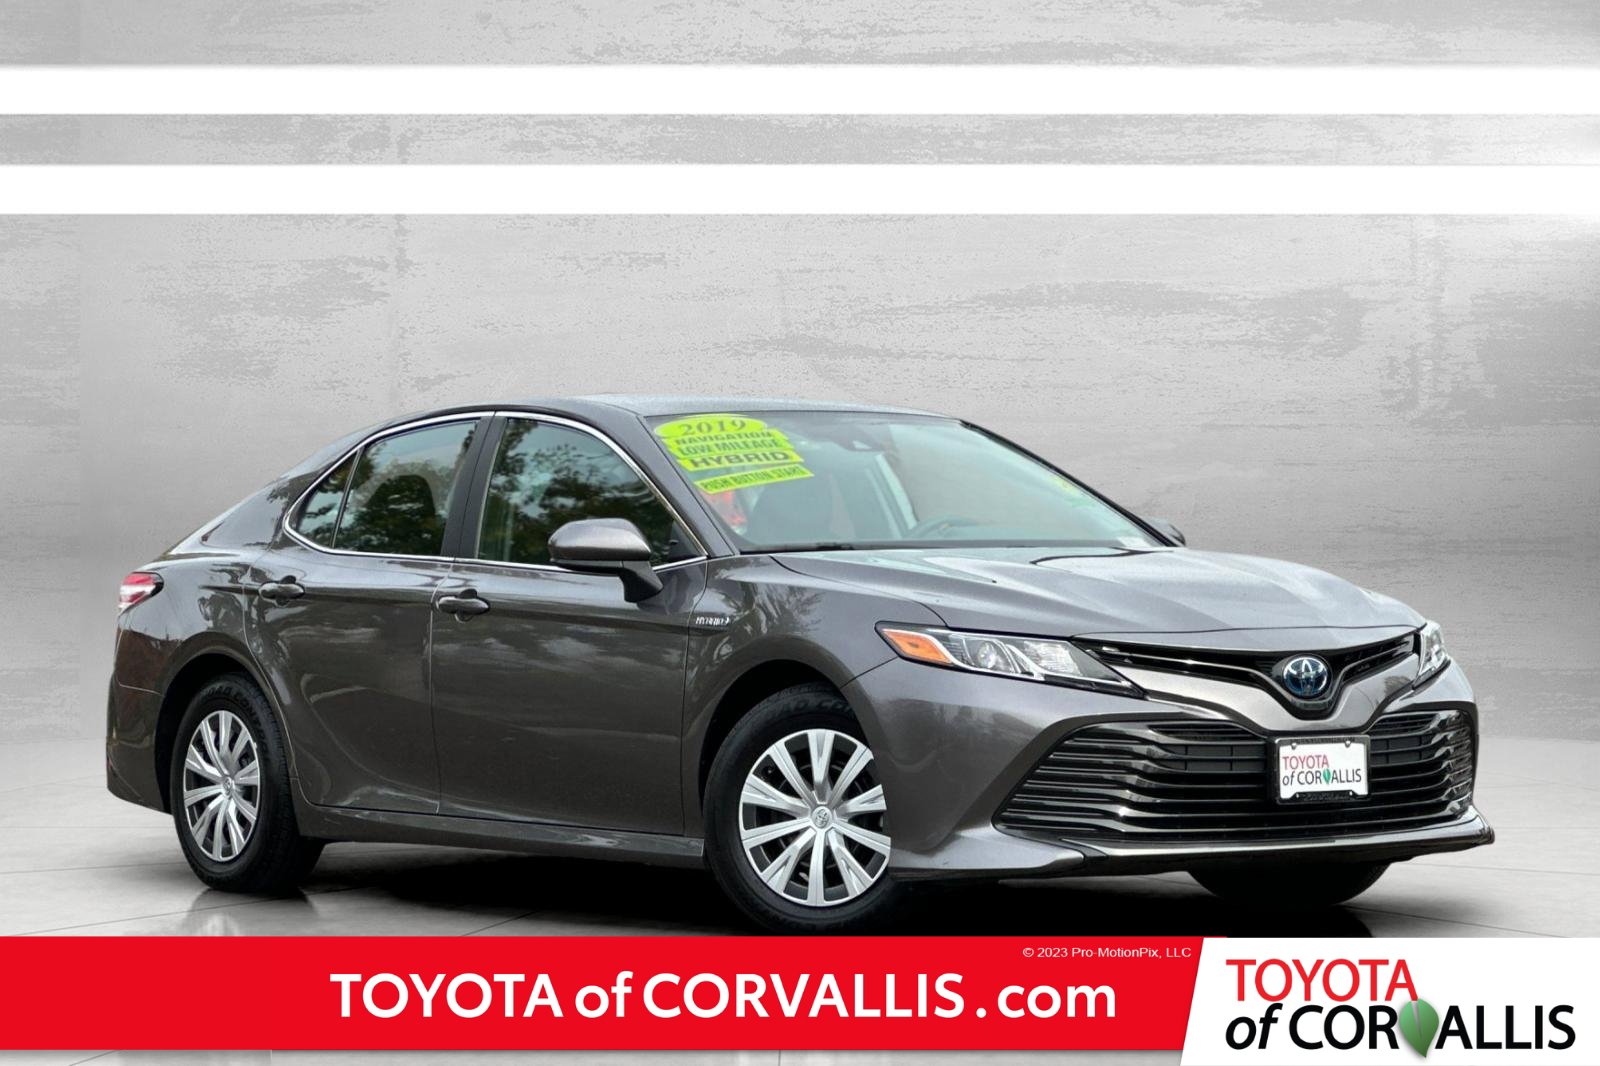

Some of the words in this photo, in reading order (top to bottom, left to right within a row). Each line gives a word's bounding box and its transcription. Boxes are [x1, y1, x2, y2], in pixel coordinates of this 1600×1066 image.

[678, 419, 747, 436] 2019
[675, 431, 773, 446] NAVIGATION
[677, 443, 710, 457] LOW
[715, 439, 781, 453] MILEAGE
[689, 451, 790, 468] HYBRID
[1282, 755, 1329, 770] TOYOTA
[1282, 771, 1296, 786] of
